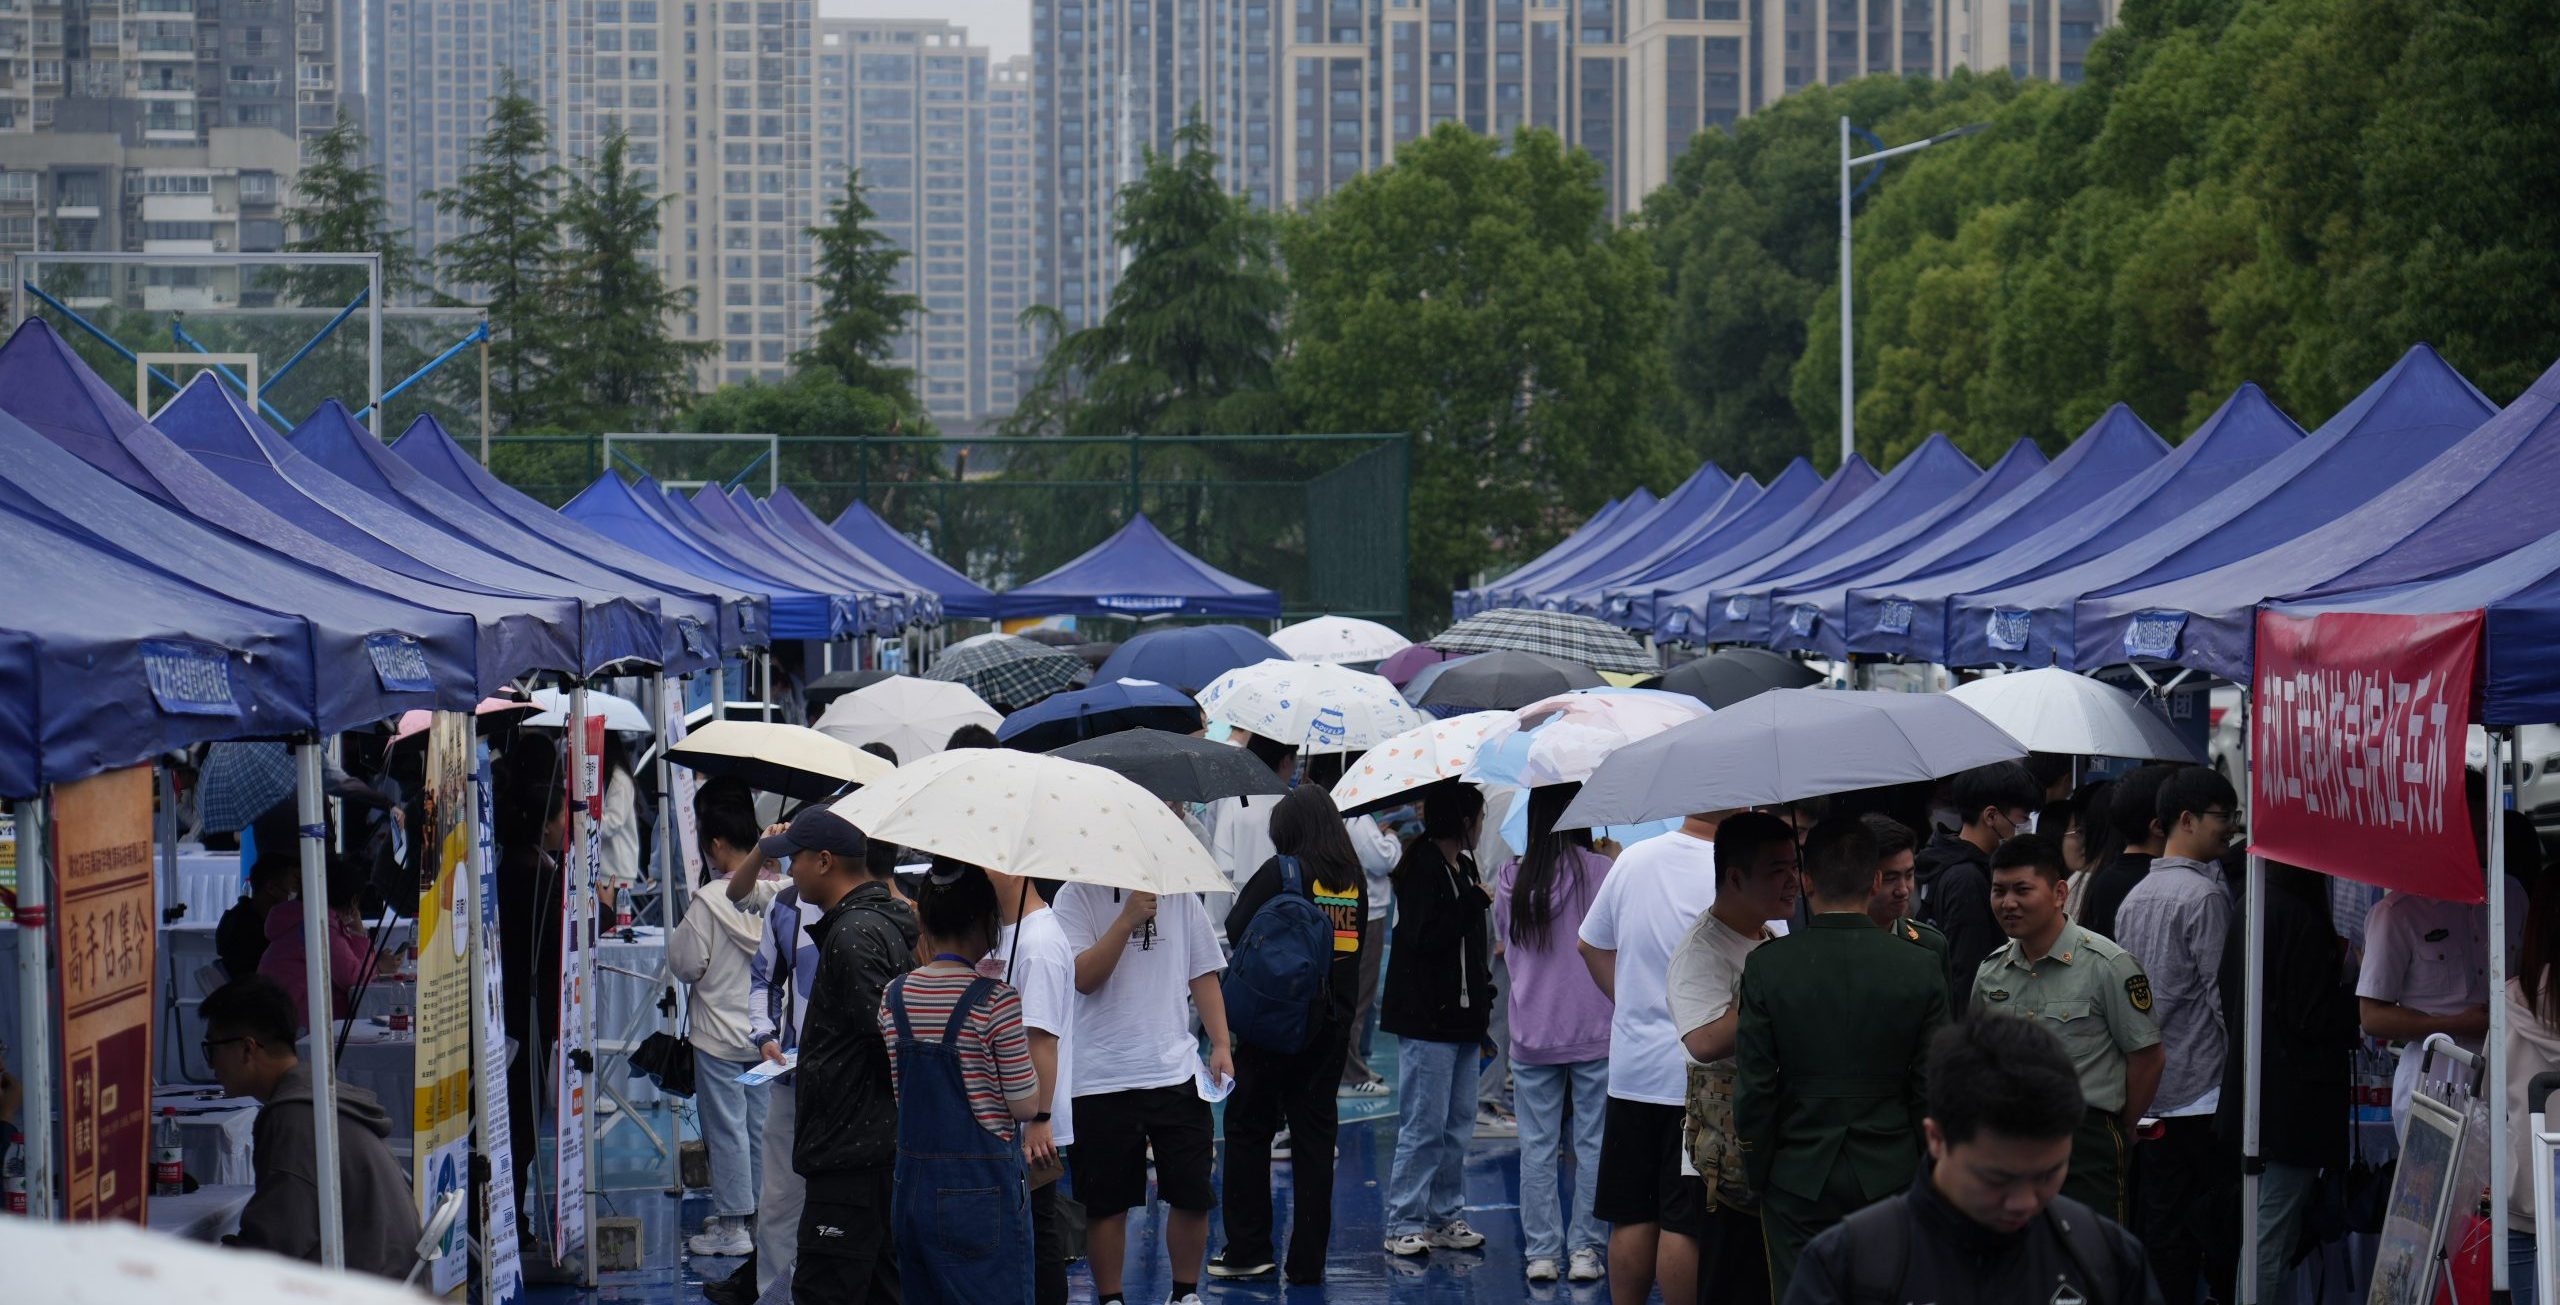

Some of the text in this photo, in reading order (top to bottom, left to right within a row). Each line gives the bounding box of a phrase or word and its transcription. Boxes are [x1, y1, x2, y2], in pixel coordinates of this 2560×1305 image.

[1315, 722, 1343, 734] LOVELY
[2262, 664, 2448, 835] 武汉工程科技学院征兵办
[68, 897, 148, 992] 高手召集令
